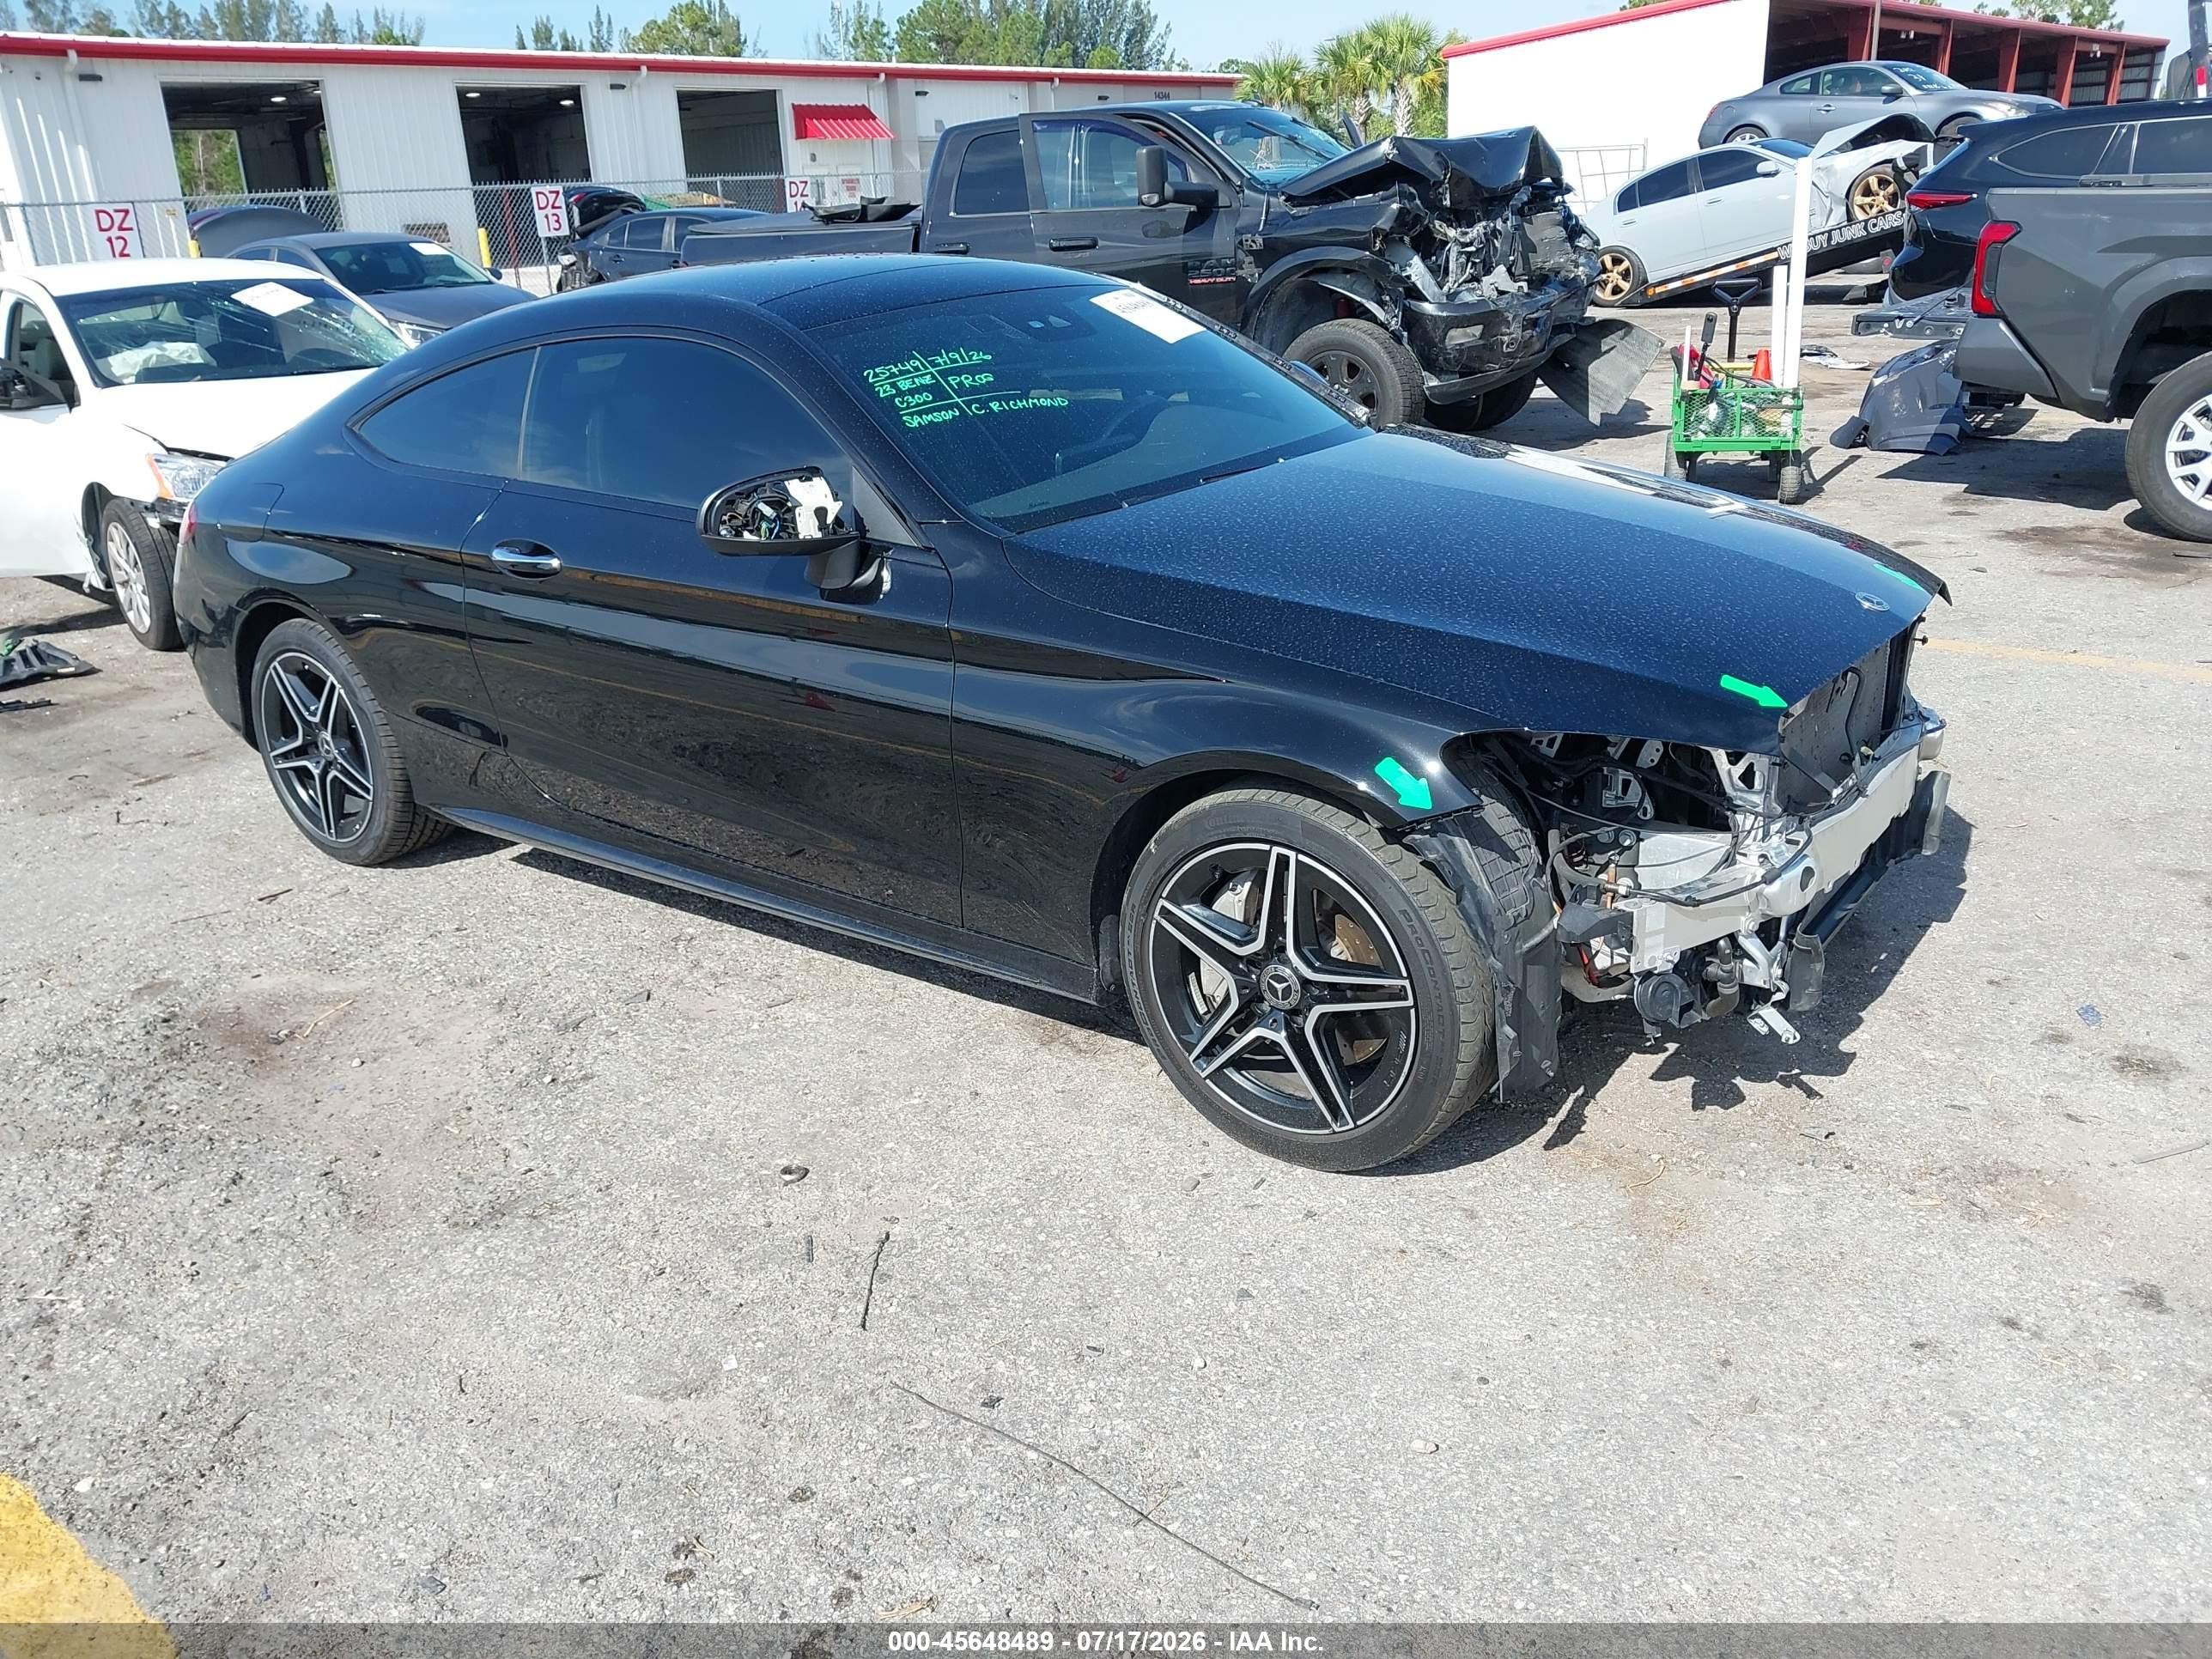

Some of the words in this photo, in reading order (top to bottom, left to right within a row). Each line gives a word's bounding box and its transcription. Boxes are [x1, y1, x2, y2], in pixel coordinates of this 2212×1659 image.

[789, 180, 809, 198] DZ
[536, 190, 562, 210] DZ
[94, 208, 134, 232] DZ
[544, 213, 562, 233] 13
[1831, 222, 1867, 246] JUNK
[1868, 210, 1904, 234] CARS
[106, 236, 131, 258] 12
[927, 347, 993, 367] 7/9/26
[863, 359, 925, 383] 25749
[875, 384, 896, 398] 23
[896, 374, 936, 391] BENZ
[895, 392, 933, 408] C300
[902, 408, 960, 428] SAMSON
